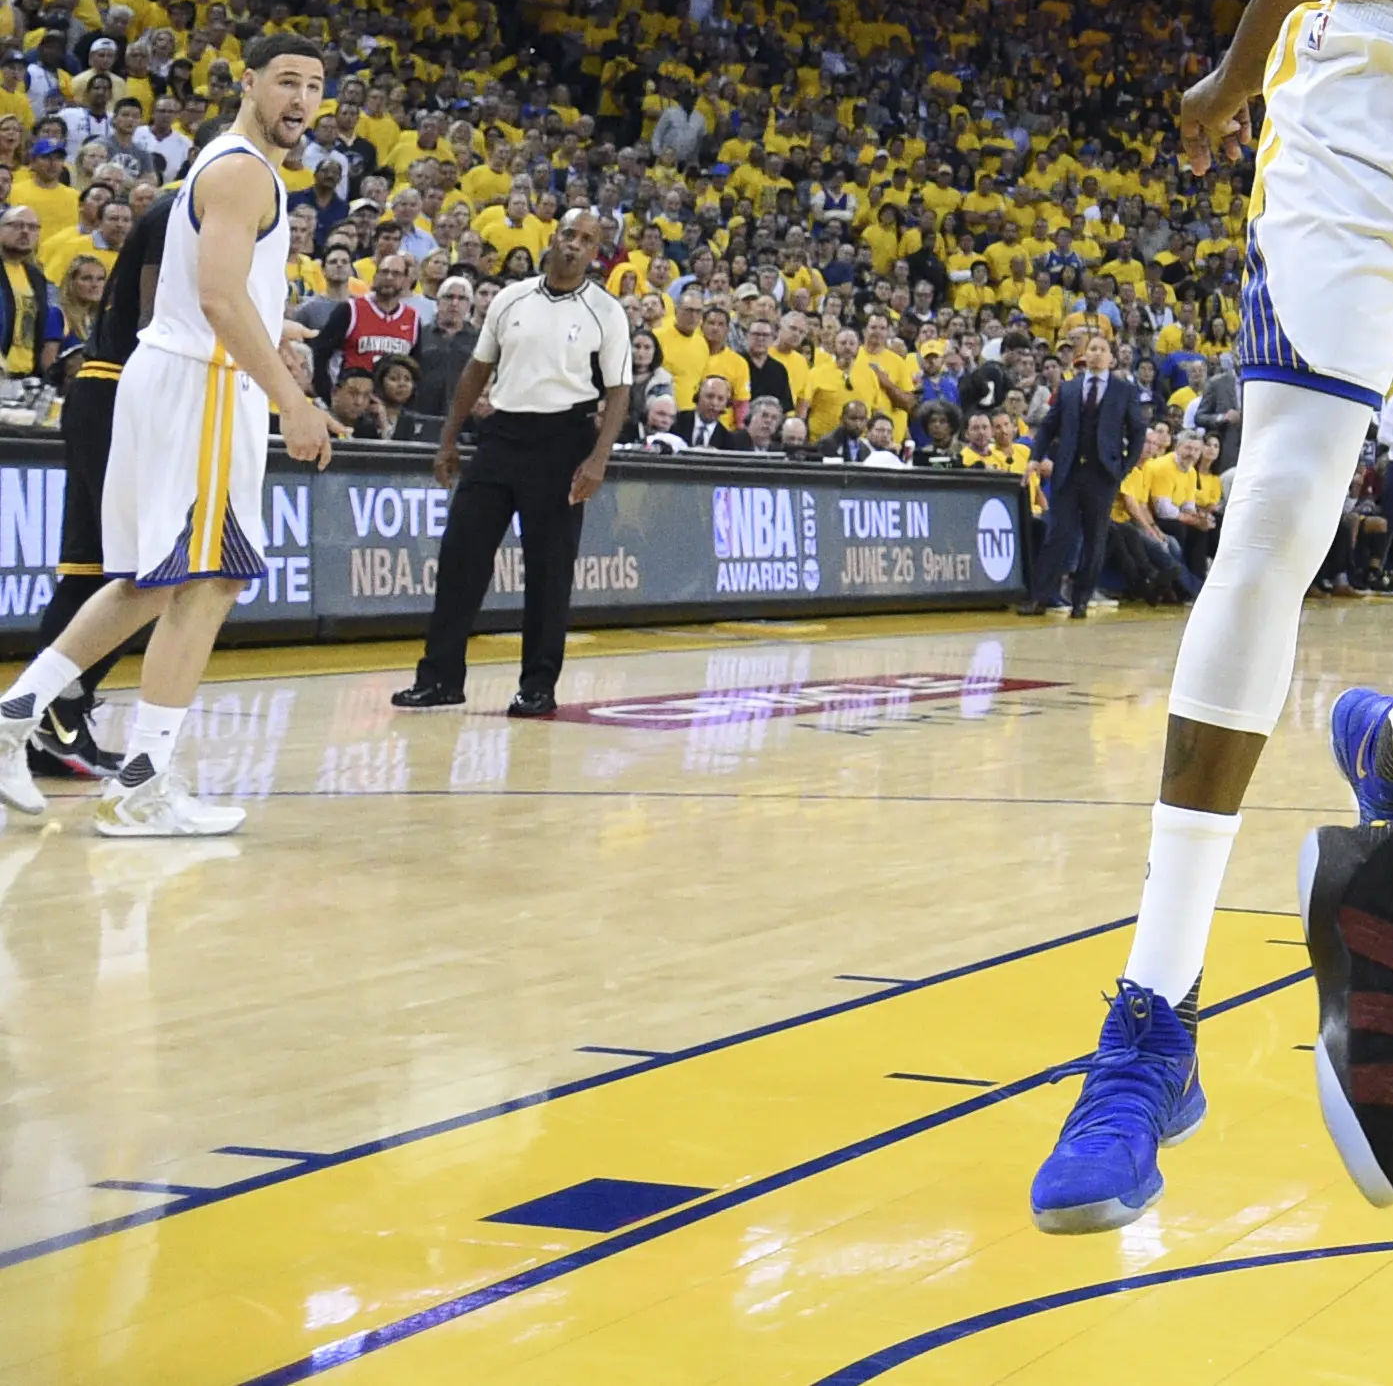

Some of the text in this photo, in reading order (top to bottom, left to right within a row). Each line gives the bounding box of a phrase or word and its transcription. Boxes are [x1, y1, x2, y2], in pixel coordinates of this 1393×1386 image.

[348, 487, 449, 538] VOTE
[730, 487, 797, 558] NBA
[839, 499, 929, 538] TUNE IN
[717, 561, 799, 593] AWARDS
[841, 545, 888, 584] JUNE
[892, 546, 915, 582] 26
[957, 554, 971, 580] ET
